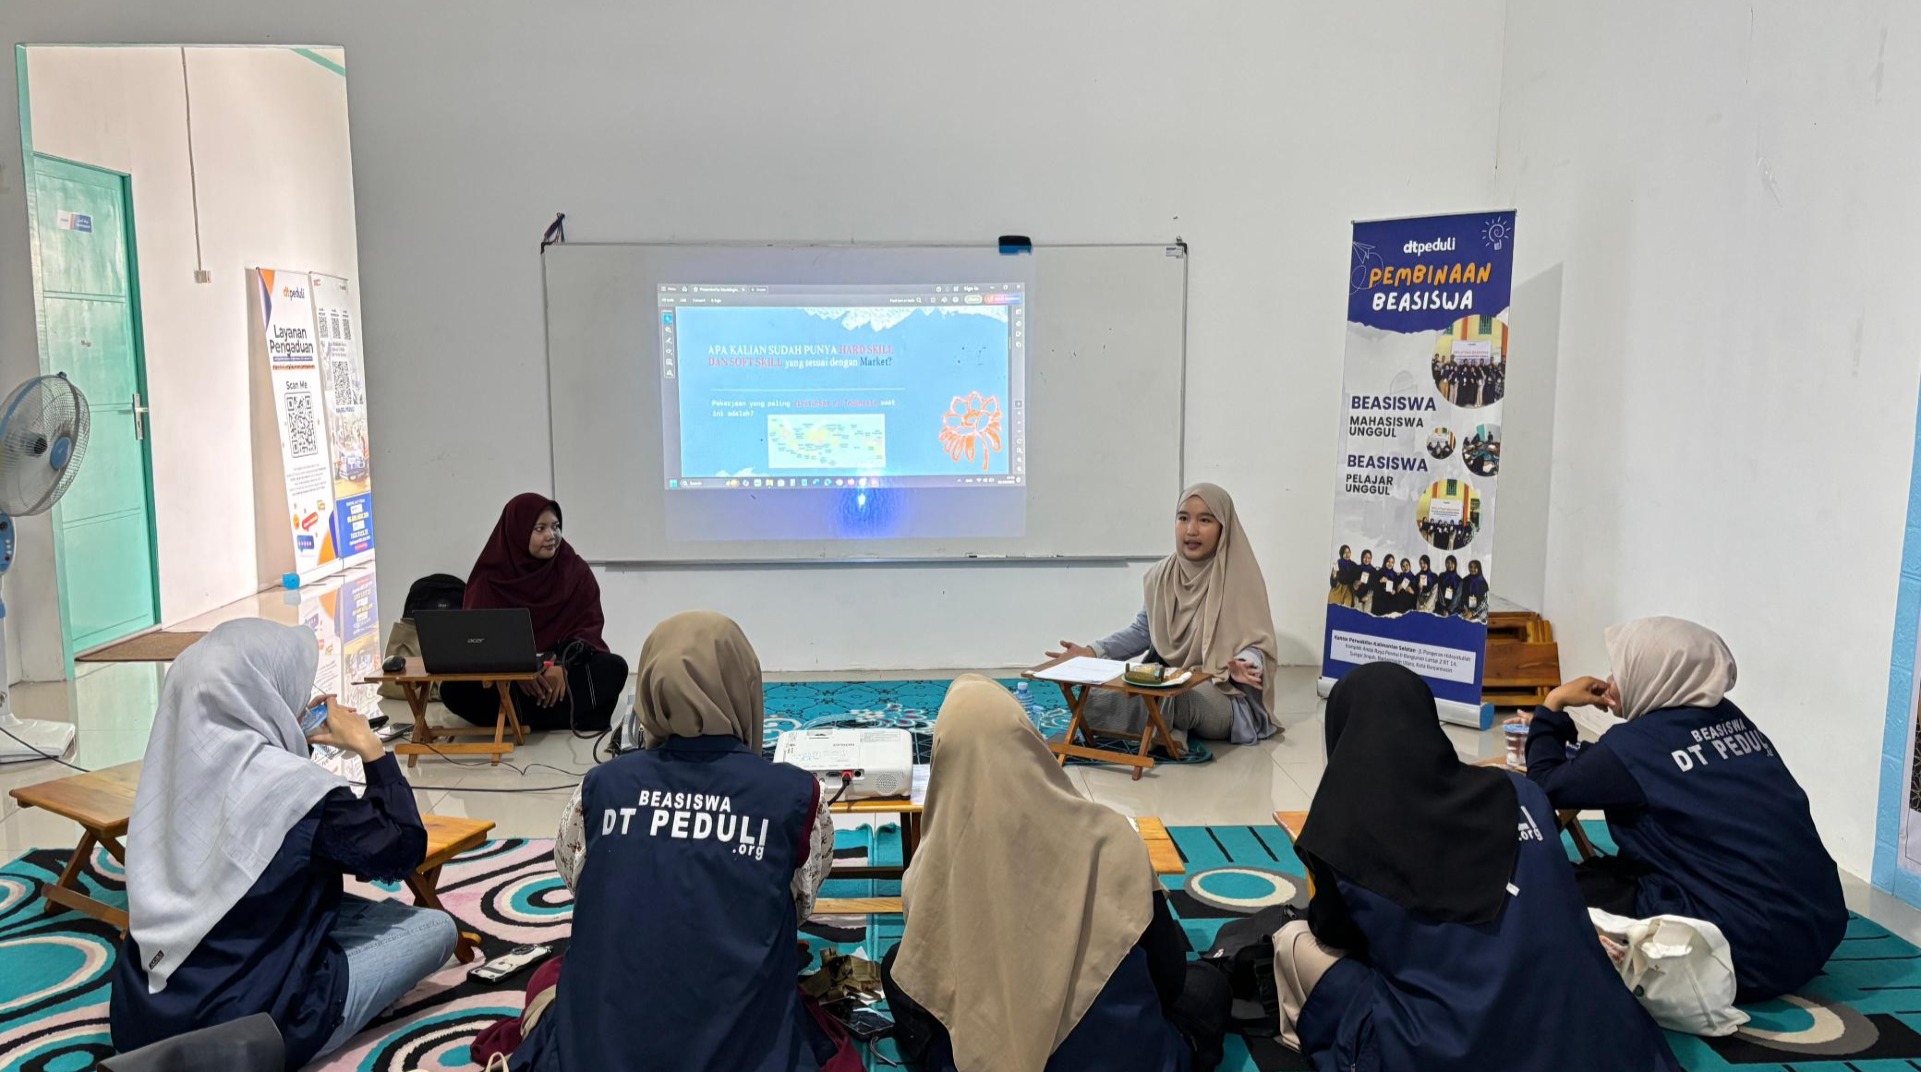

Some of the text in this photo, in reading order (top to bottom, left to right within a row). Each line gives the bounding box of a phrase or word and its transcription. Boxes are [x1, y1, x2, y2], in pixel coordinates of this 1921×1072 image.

[1403, 238, 1456, 256] dtpeduli
[1368, 262, 1492, 288] PEMBINAAN
[284, 287, 304, 300] dtpeduli
[1372, 290, 1473, 312] BEASISWA
[274, 325, 307, 341] Layanan
[270, 340, 314, 358] Pengaduan
[708, 344, 894, 355] APA KALIAN SUDAH PUNYA HARD SKILL
[708, 356, 892, 368] DAN SOFT SKILL yang sesuai dengan Market?
[286, 380, 307, 390] Scan Me
[768, 400, 791, 408] paling
[1351, 396, 1436, 412] BEASISWA
[1350, 416, 1424, 428] MAHASISWA
[1349, 426, 1397, 438] UNGGUL
[1347, 454, 1428, 472] BEASISWA
[1346, 474, 1394, 486] PELAJAR
[1345, 484, 1390, 496] UNGGUL
[1690, 718, 1747, 742] BEASISWA
[1671, 730, 1768, 772] DT PEDUL
[638, 790, 731, 812] BEASISWA
[602, 808, 769, 846] DT PEDULI
[732, 842, 765, 861] .org
